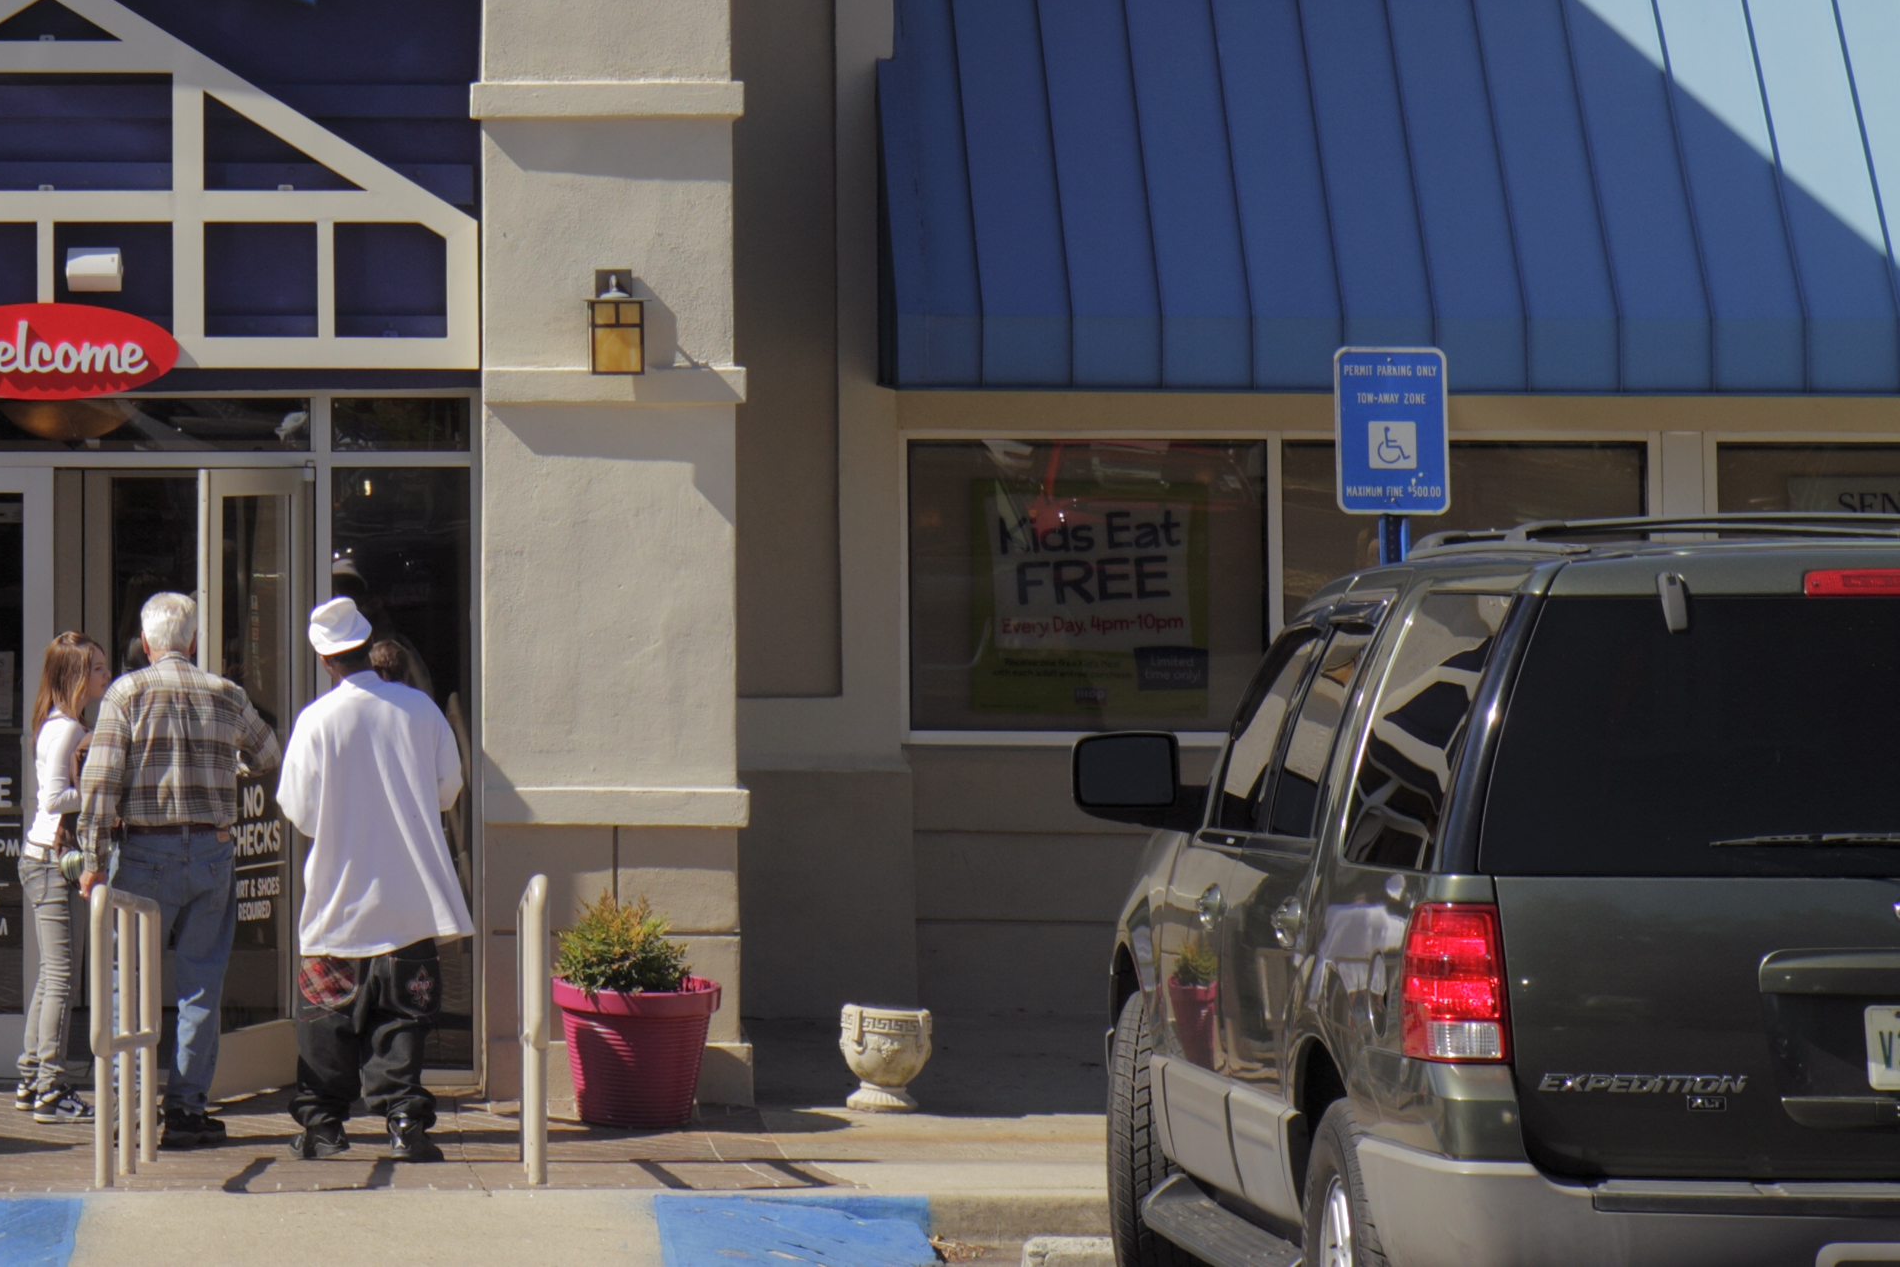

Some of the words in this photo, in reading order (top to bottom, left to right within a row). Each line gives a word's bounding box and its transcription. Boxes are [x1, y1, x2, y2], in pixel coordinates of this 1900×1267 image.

[1344, 365, 1373, 376] PERMIT
[1377, 365, 1412, 376] PARKING
[1416, 365, 1437, 377] ONLY
[1357, 392, 1399, 404] TOW-AWAY
[1404, 393, 1426, 404] ZONE
[1346, 485, 1383, 497] MAXIMUM
[1386, 485, 1404, 497] FINE
[1408, 485, 1441, 498] $500.00
[999, 513, 1095, 555] Kids
[1106, 510, 1181, 549] Eat
[1017, 555, 1170, 605] FREE
[1001, 618, 1049, 638] Every
[1090, 613, 1184, 634] 4pm-10pm
[1058, 658, 1077, 667] free
[1151, 655, 1195, 667] Limited
[1144, 668, 1170, 680] time
[243, 784, 264, 819] NO
[250, 878, 256, 898] &
[257, 876, 280, 897] SHOES
[238, 900, 271, 922] REQUIRED
[1538, 1072, 1749, 1094] EXPEDITION
[1691, 1097, 1722, 1109] XLT
